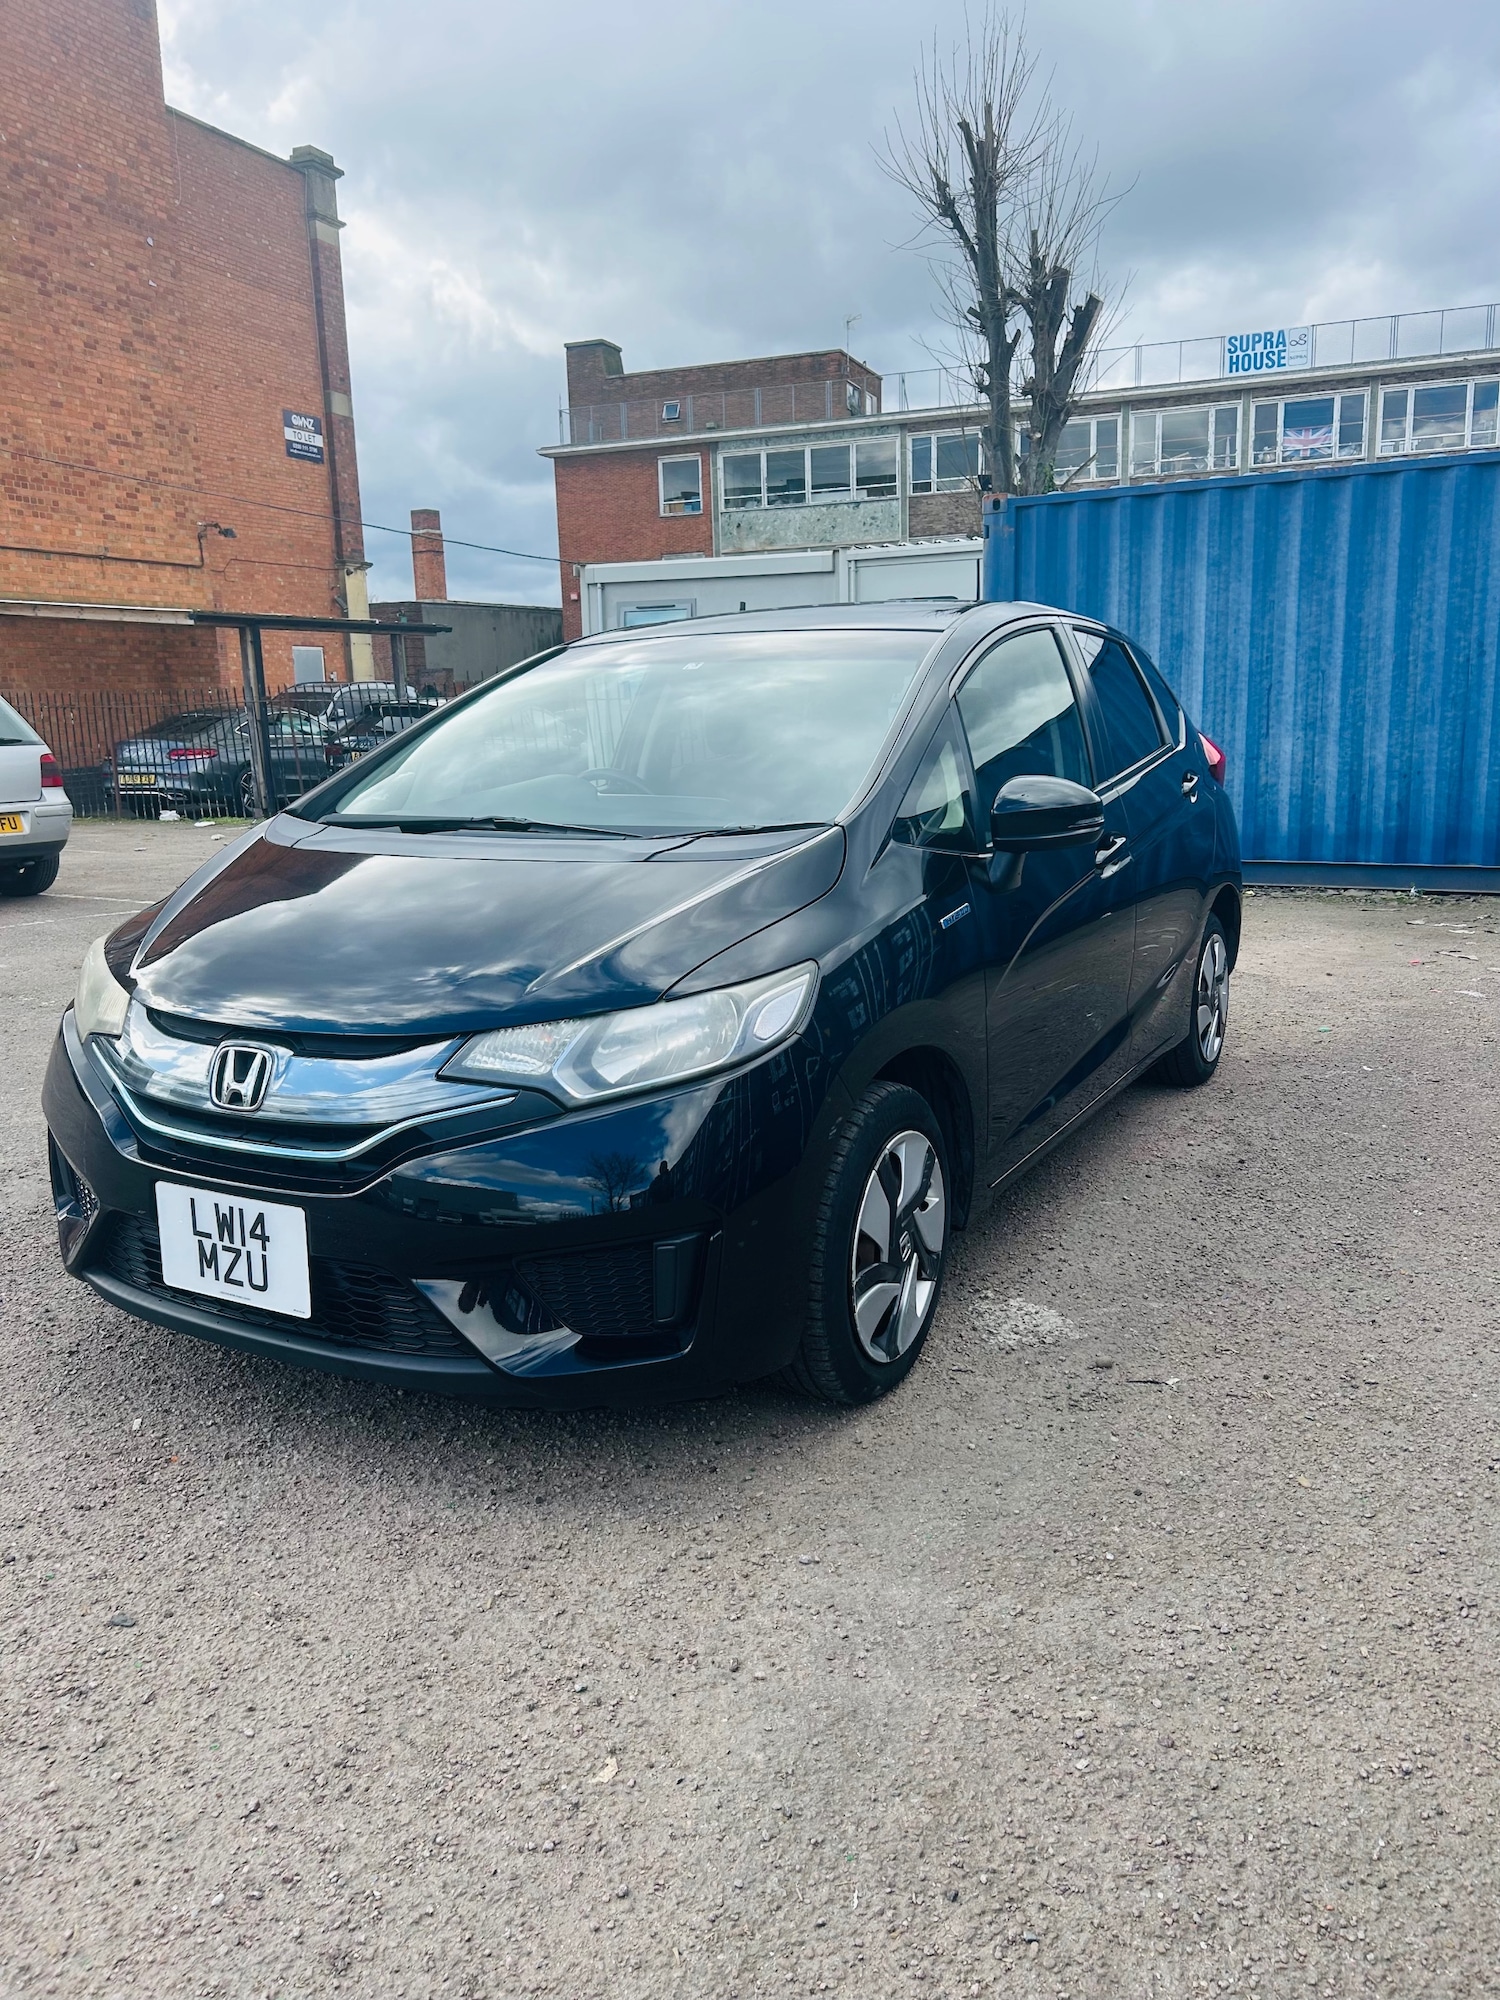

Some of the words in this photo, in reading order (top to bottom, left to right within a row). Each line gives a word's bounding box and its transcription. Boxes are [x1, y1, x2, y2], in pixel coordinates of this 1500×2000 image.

[1227, 329, 1287, 354] SUPRA
[1228, 349, 1287, 373] HOUSE
[292, 430, 302, 440] TO
[304, 433, 316, 444] LET
[190, 1197, 270, 1251] LW14
[197, 1239, 269, 1293] MZU
